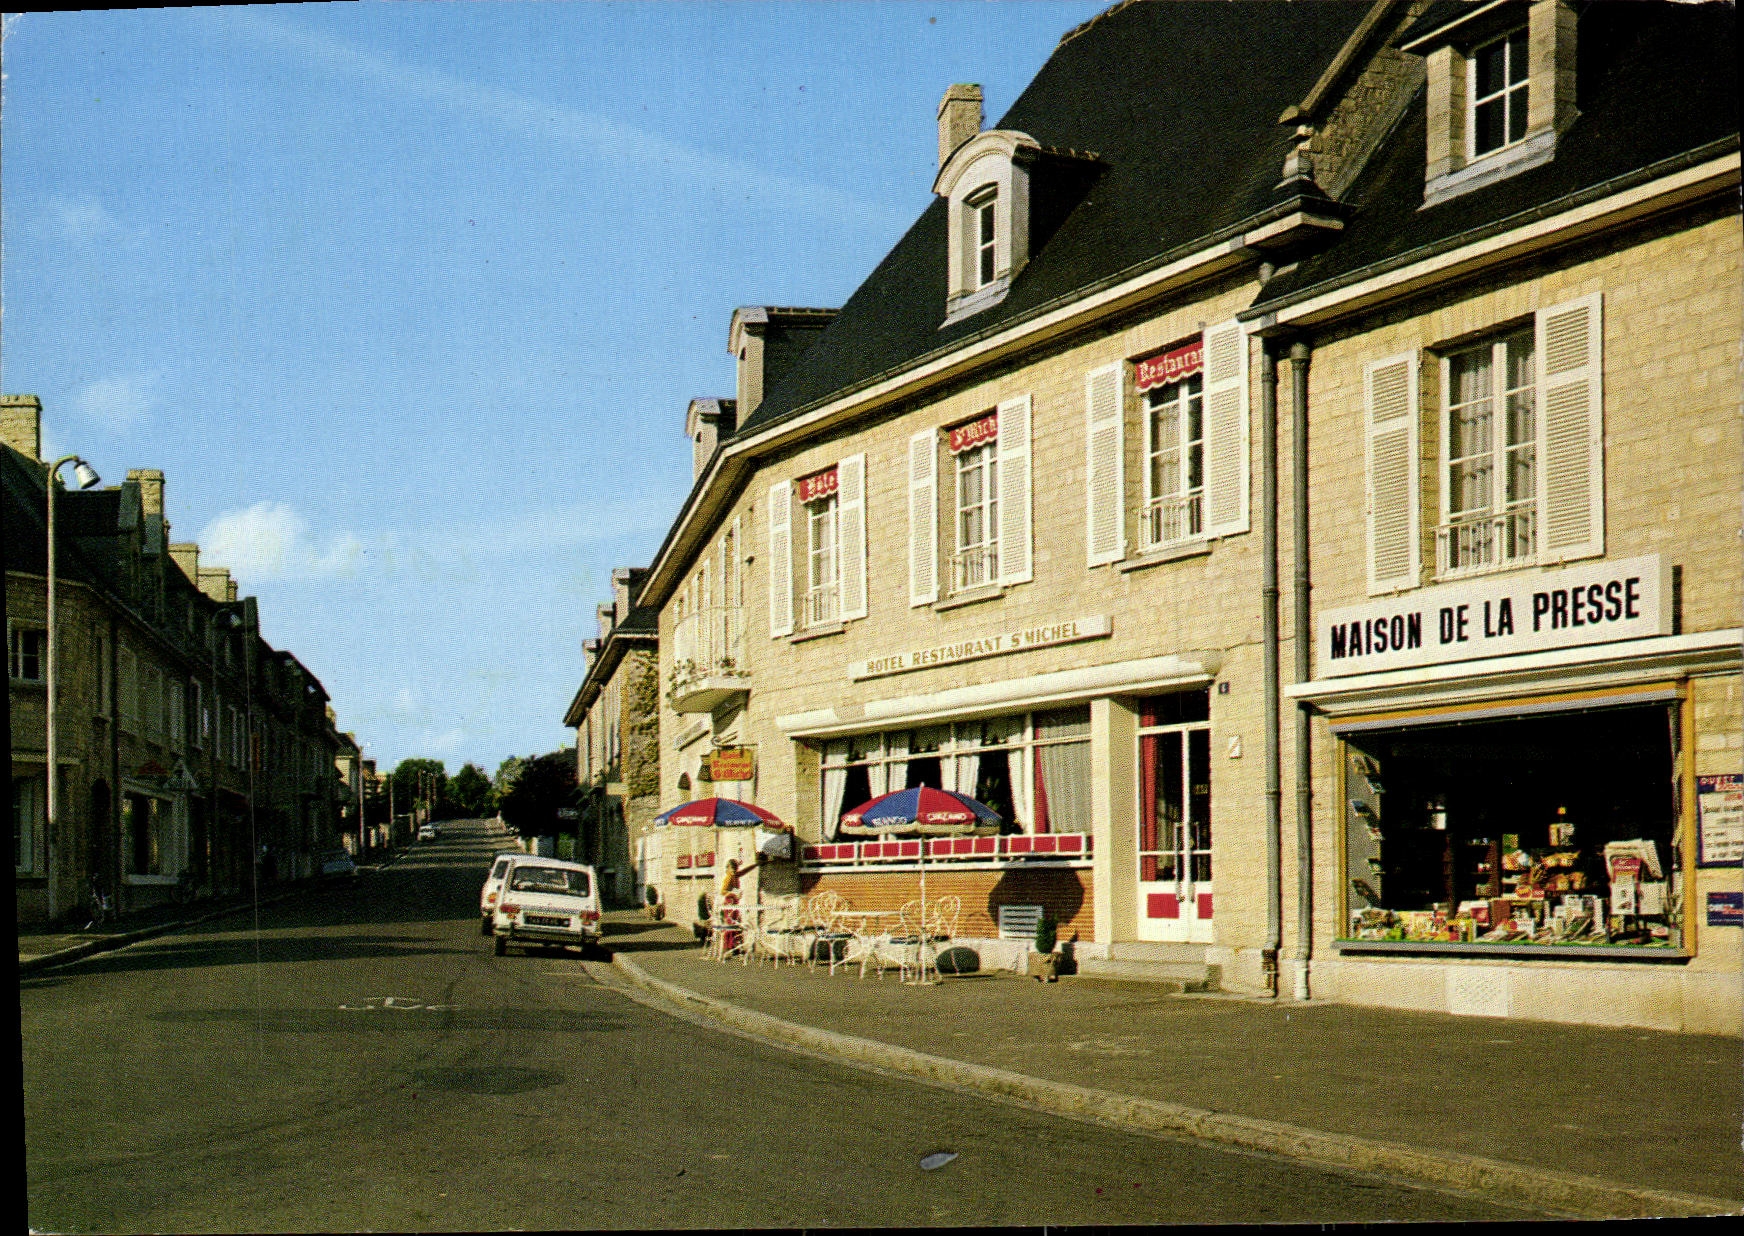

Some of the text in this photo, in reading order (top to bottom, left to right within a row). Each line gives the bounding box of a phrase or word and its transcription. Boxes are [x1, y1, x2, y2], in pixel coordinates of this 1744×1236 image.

[912, 635, 1003, 665] RESTAURANT
[1024, 622, 1081, 643] MICHEL
[1330, 576, 1641, 660] MAISON DE LA PRESSE
